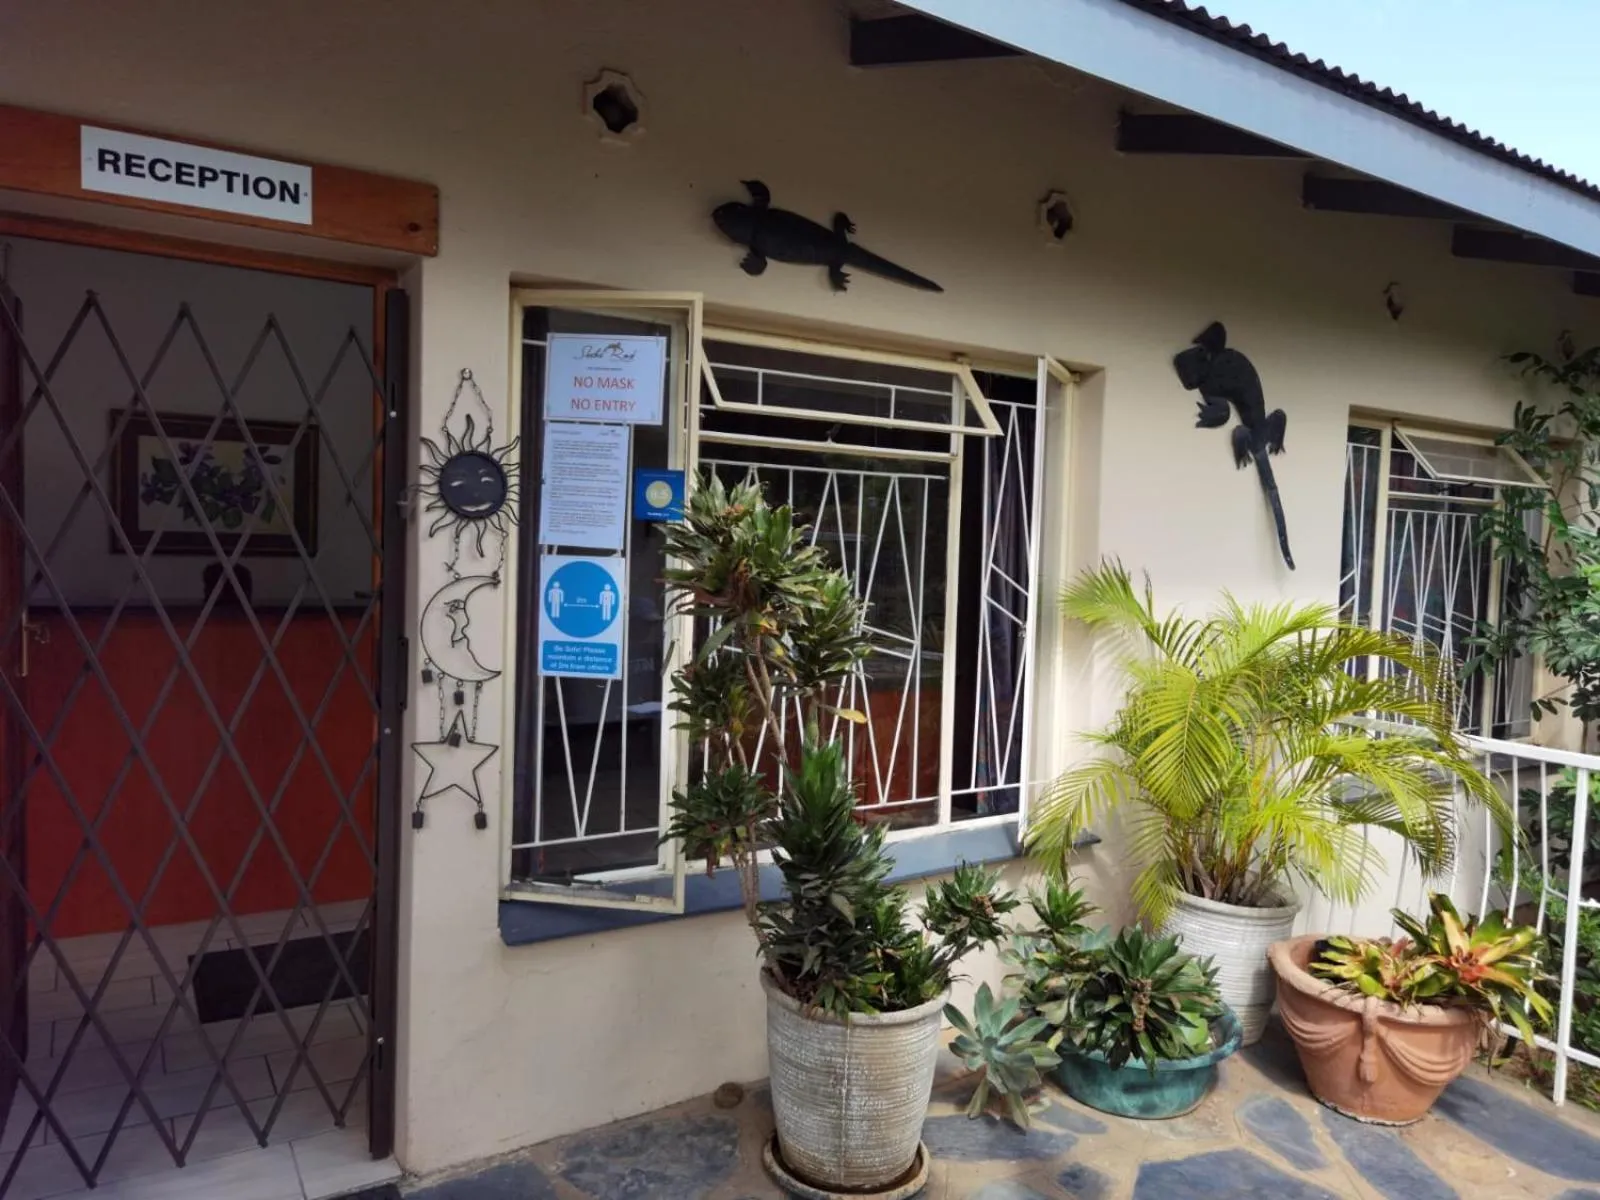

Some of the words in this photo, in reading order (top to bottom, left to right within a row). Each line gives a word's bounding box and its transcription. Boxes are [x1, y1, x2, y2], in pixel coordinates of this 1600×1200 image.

[97, 148, 301, 204] RECEPTION
[573, 376, 593, 387] NO
[597, 377, 635, 389] MASK
[571, 398, 591, 410] NO
[595, 399, 637, 412] ENTRY
